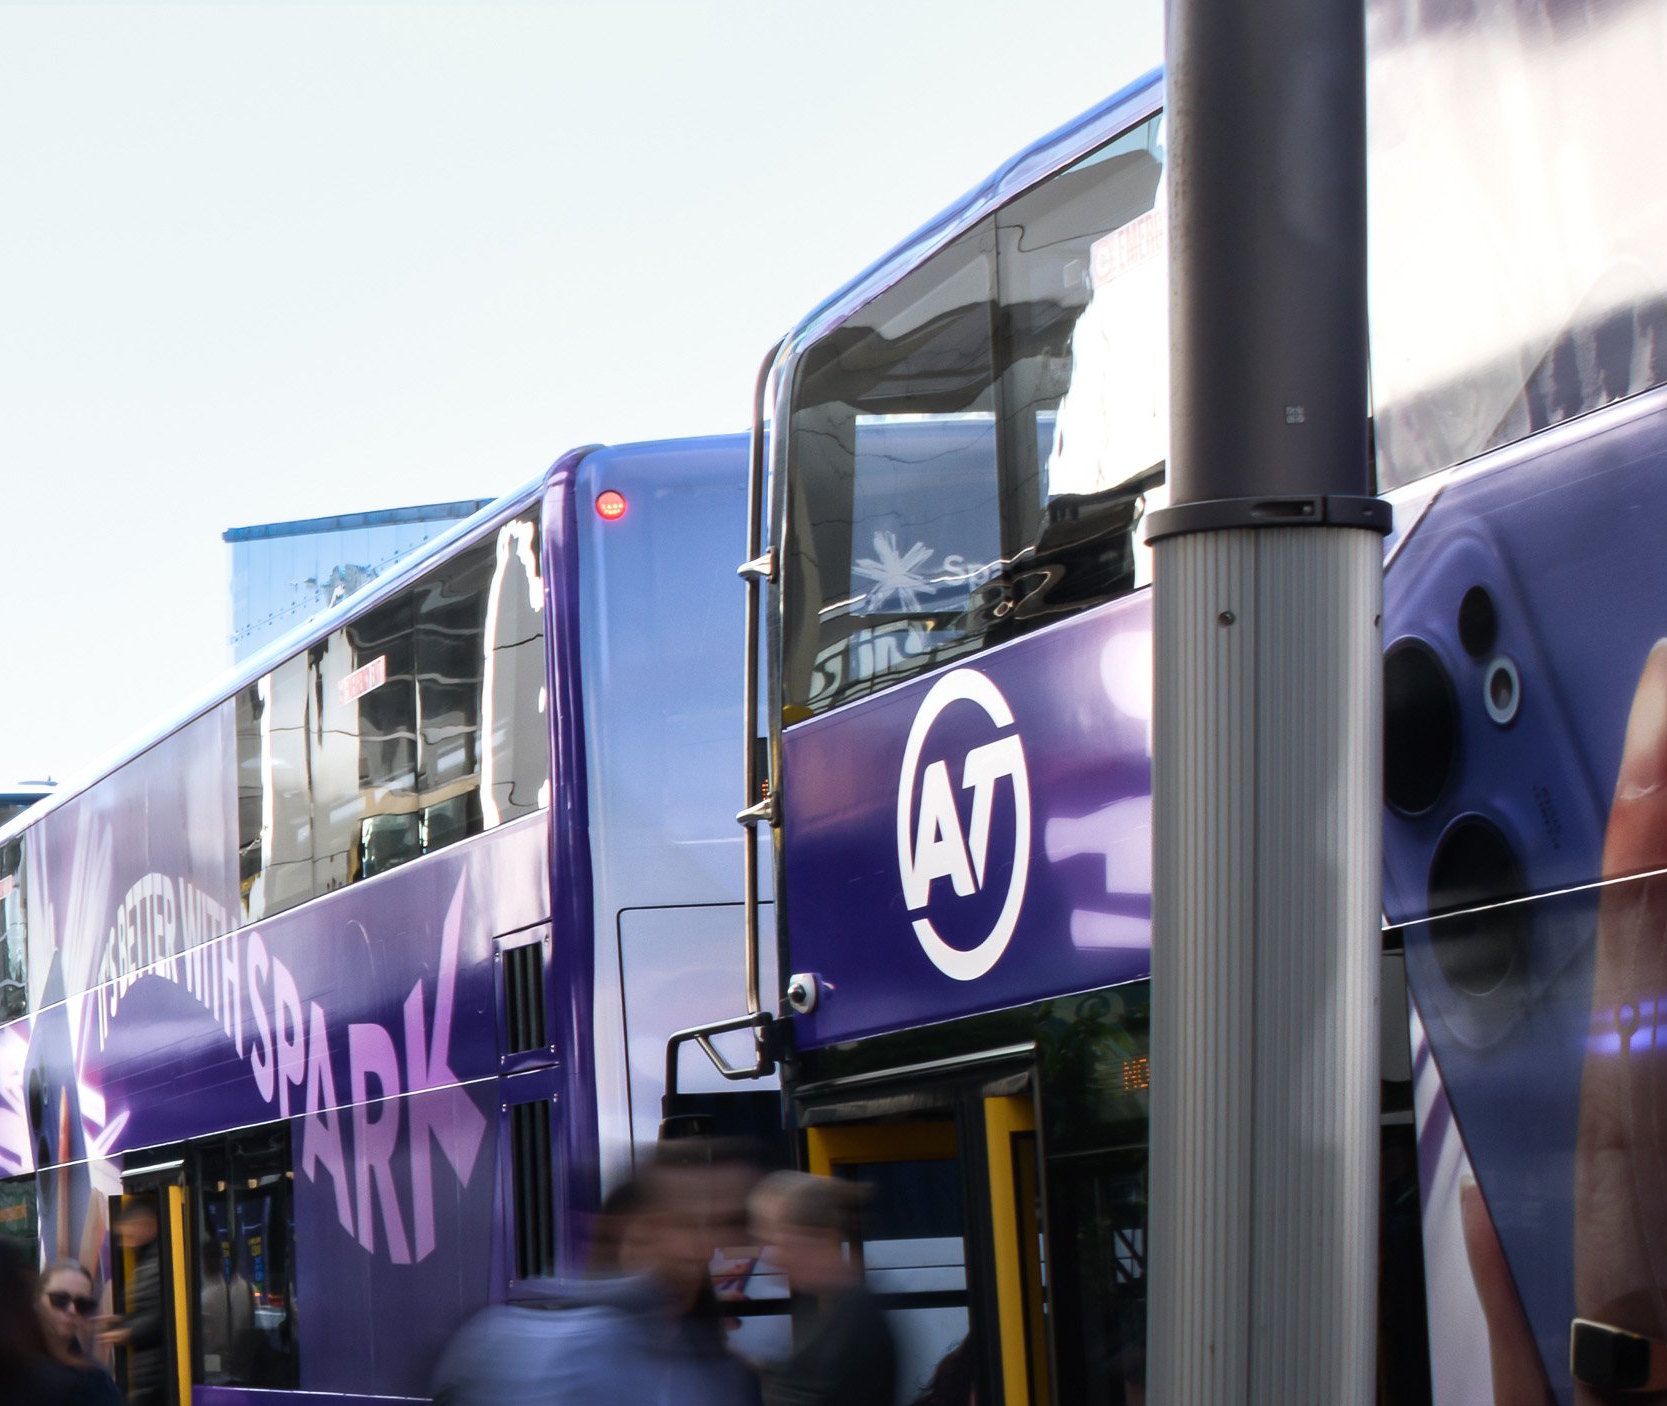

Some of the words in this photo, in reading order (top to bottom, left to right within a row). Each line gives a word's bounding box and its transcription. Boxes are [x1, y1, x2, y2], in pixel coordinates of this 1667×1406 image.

[117, 872, 178, 999] BETTER
[179, 876, 244, 1060] WITH
[247, 861, 487, 1265] SPARK
